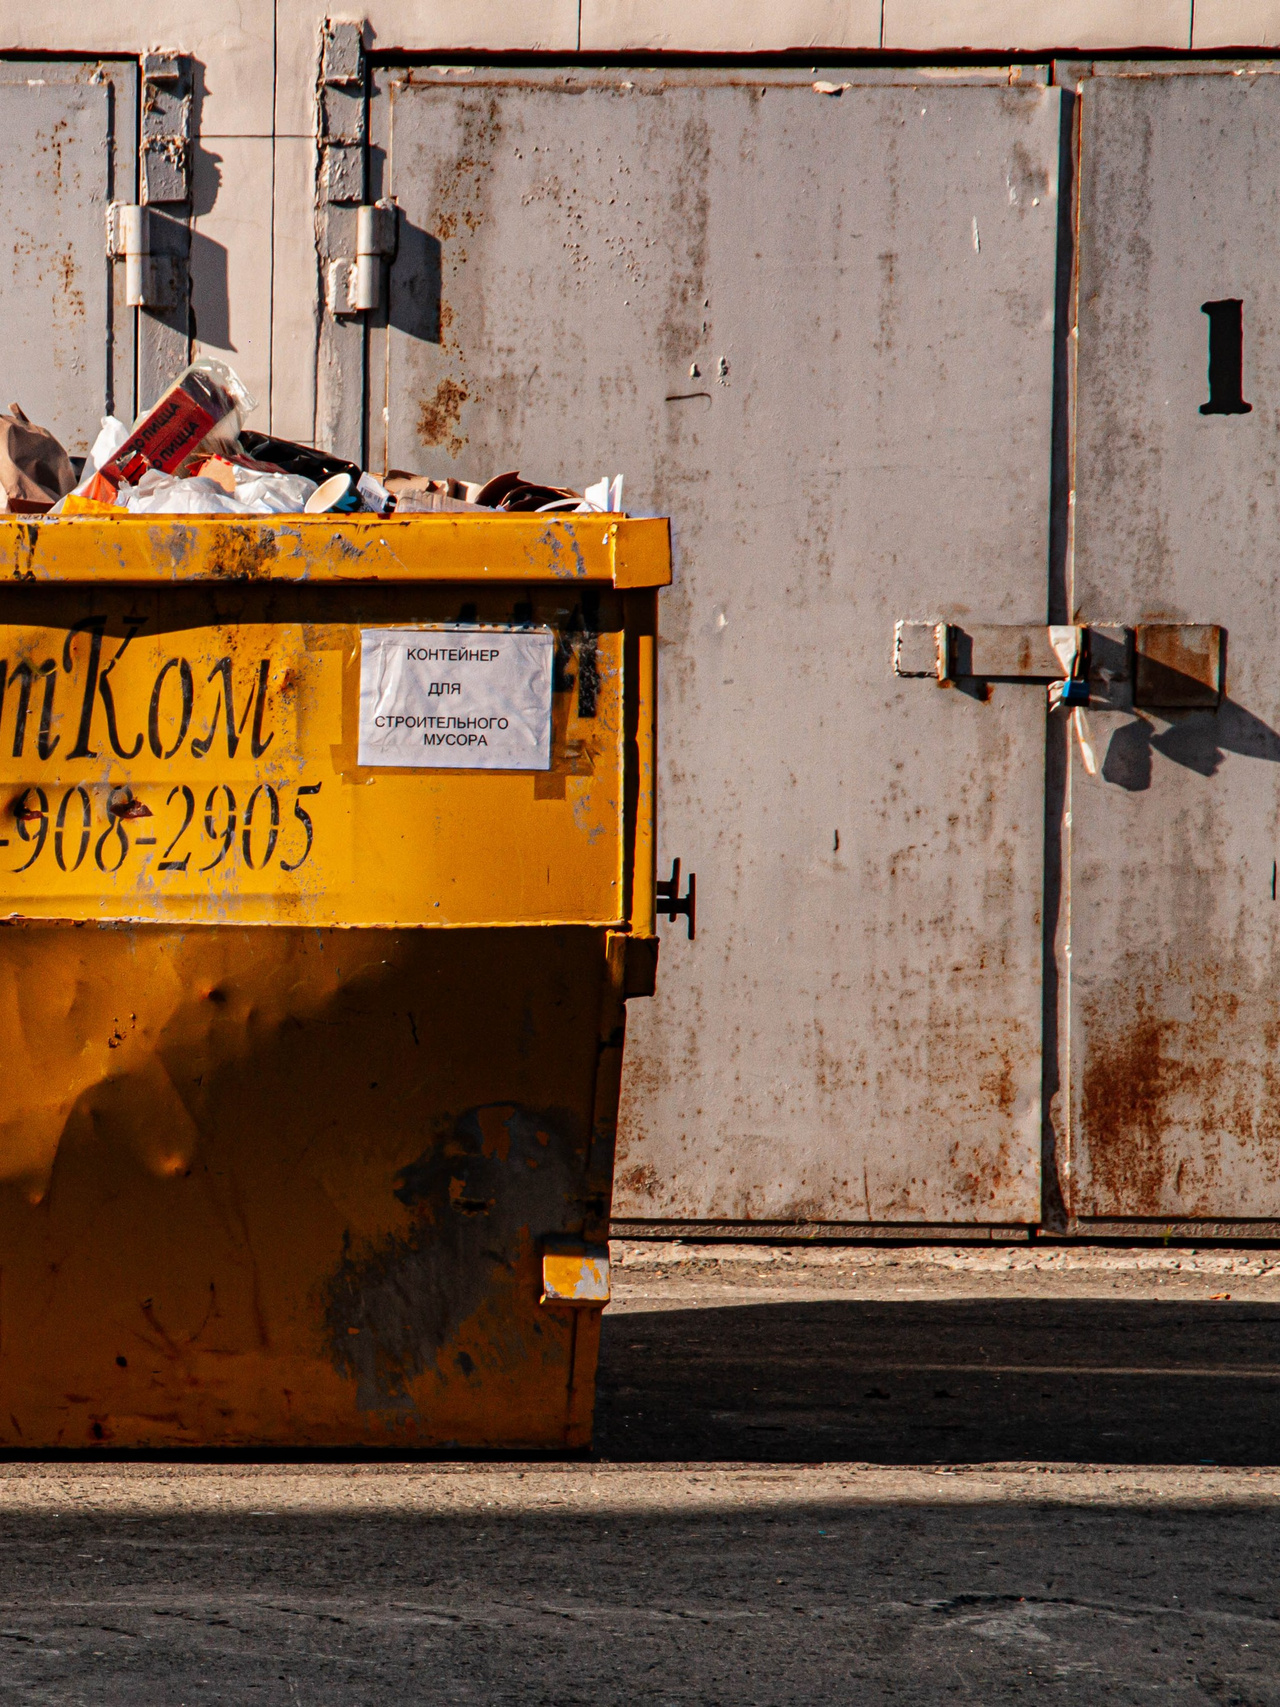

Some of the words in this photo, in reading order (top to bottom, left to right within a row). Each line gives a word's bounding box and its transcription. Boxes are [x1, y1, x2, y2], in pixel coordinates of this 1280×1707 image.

[1199, 298, 1253, 415] 1
[141, 402, 180, 441] ПИЦЦА
[160, 421, 199, 461] ПИЦЦА
[406, 646, 500, 662] КОНТЕЙНЕР
[427, 682, 461, 697] ДЛЯ
[374, 715, 509, 730] СТРОИТЕЛЬНОГО
[423, 733, 488, 746] МУСОРА
